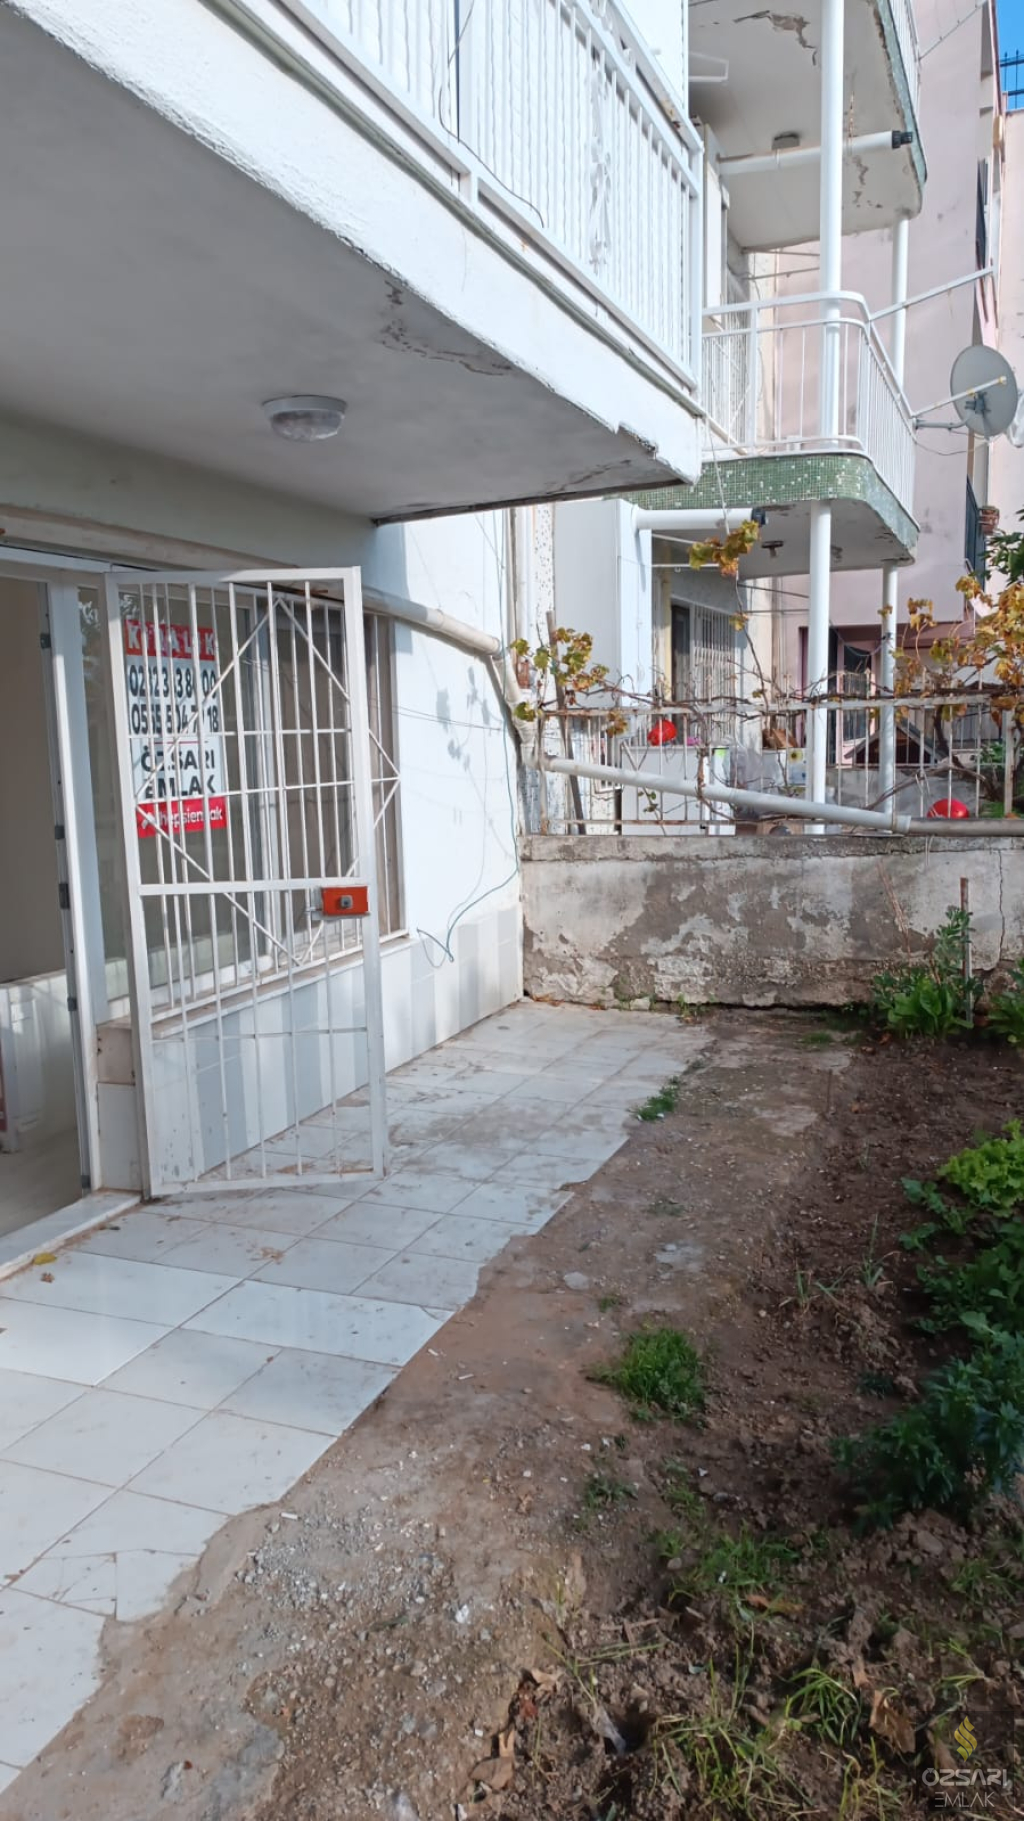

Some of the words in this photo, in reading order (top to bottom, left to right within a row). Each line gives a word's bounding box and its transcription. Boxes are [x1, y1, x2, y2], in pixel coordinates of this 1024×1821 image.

[127, 625, 217, 656] KALK
[131, 703, 219, 735] 05554718
[144, 774, 216, 799] EMAK
[160, 806, 223, 829] hpsieak
